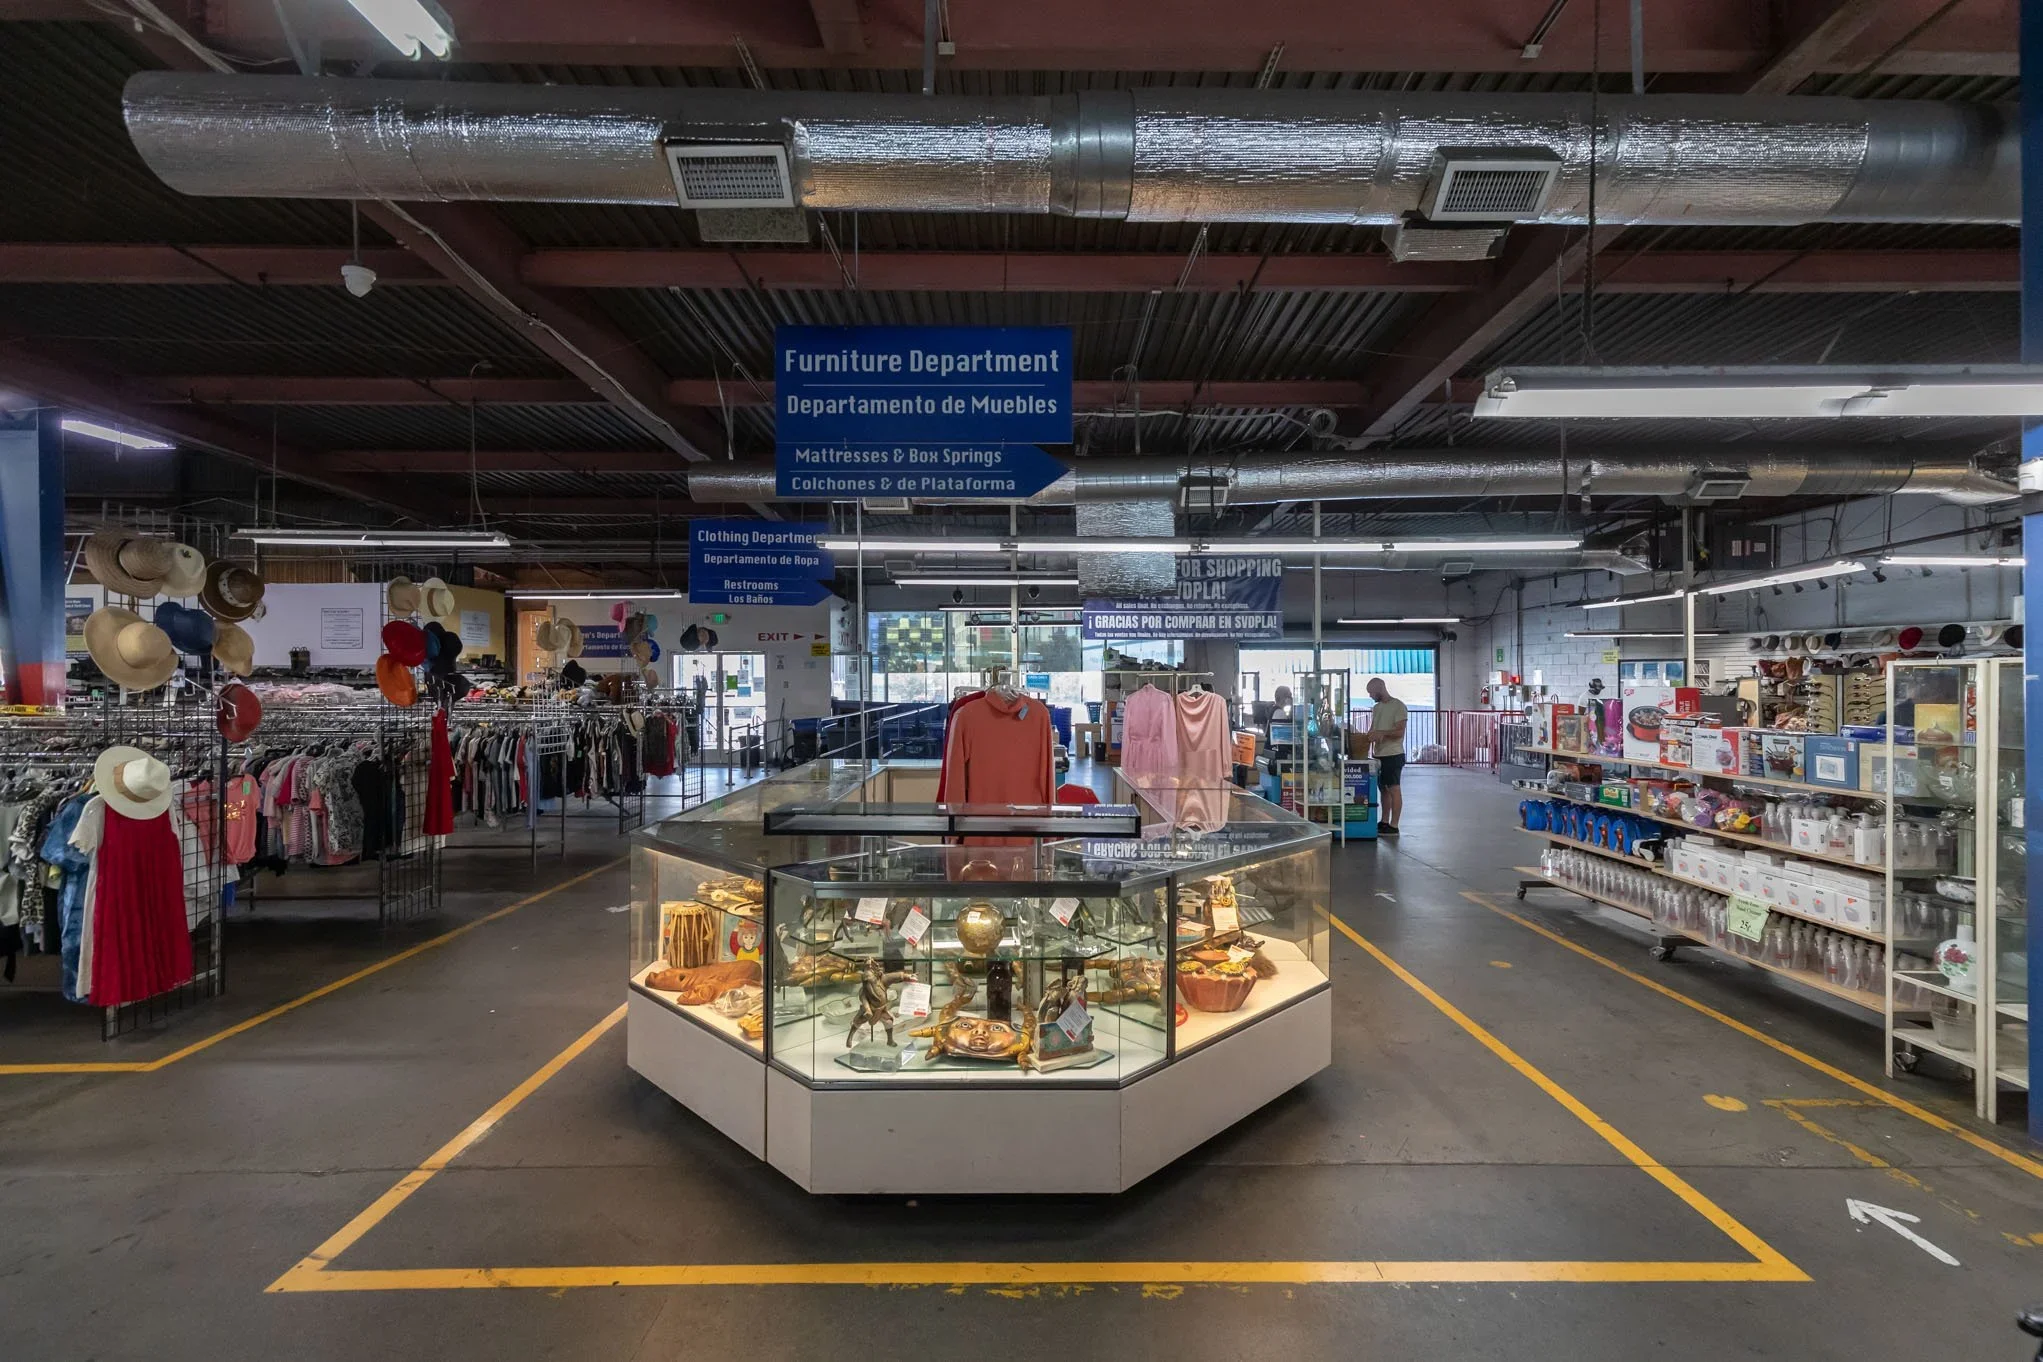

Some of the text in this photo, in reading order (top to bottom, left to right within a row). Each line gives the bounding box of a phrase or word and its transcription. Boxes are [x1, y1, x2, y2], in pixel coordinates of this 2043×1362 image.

[785, 349, 1059, 376] Furniture Department
[787, 395, 1057, 417] Departamento de Muebles
[795, 447, 1002, 468] Mattresses & Box Springs
[791, 476, 1016, 491] Colchones & de Plataforma
[697, 530, 817, 546] Clothing Departme
[703, 553, 819, 567] Departamento de Ropa
[1206, 558, 1282, 577] SHOPPING
[723, 579, 779, 591] Restrooms
[1165, 581, 1227, 600] VDPLA!
[728, 593, 774, 604] Los Baños
[1095, 615, 1139, 629] GRACIAS
[1141, 615, 1162, 629] POR
[1165, 615, 1216, 629] COMPRAR
[1219, 615, 1232, 629] EN
[1235, 615, 1277, 629] SVDPLA!
[757, 632, 789, 641] EXIT
